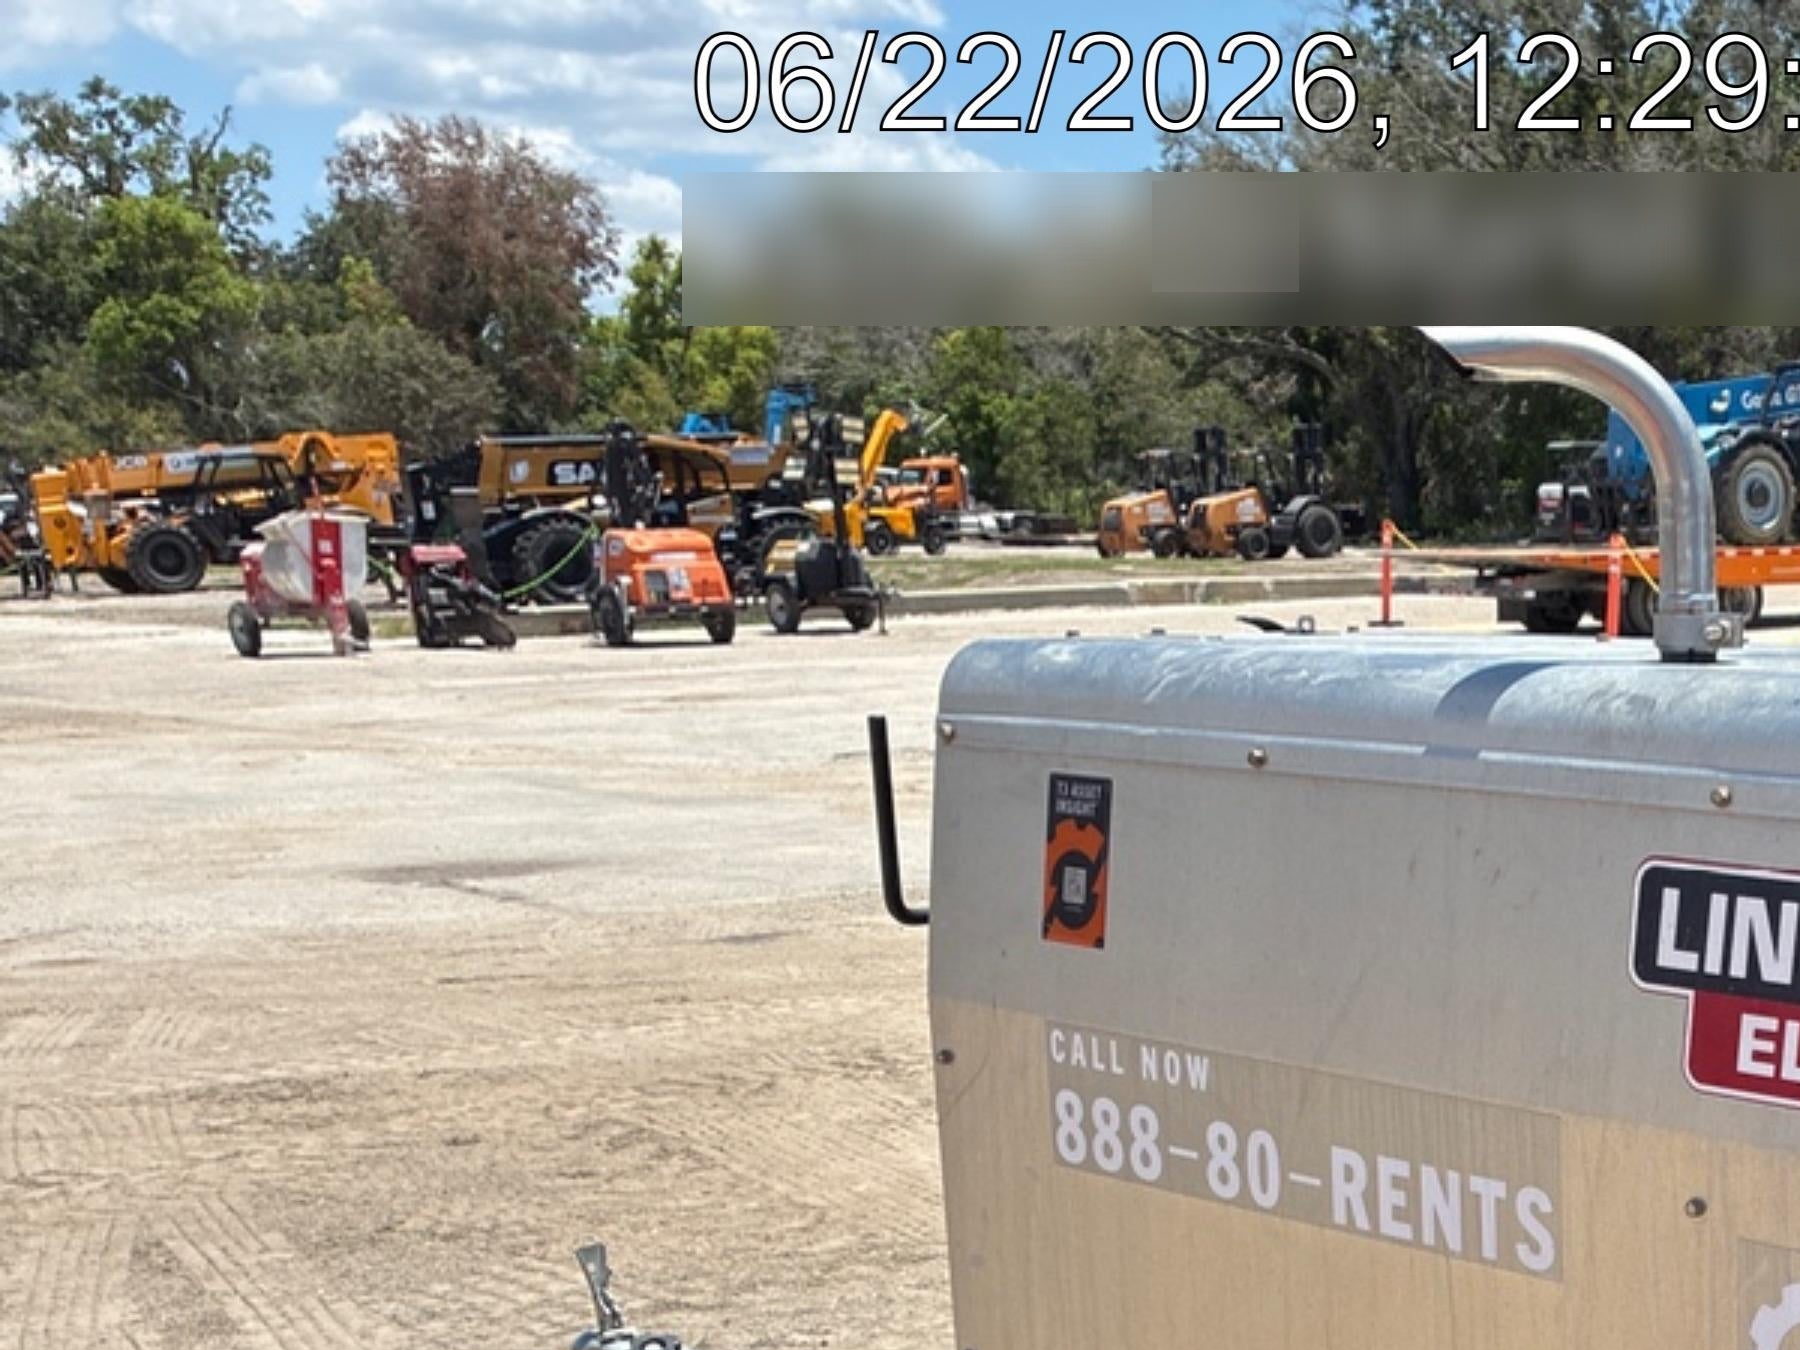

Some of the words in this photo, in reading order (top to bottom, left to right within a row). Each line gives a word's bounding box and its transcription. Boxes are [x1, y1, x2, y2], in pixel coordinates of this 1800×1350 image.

[1049, 1028, 1125, 1075] CALL
[1139, 1046, 1210, 1092] NOW
[1054, 1088, 1556, 1272] 888-80-RENTS
